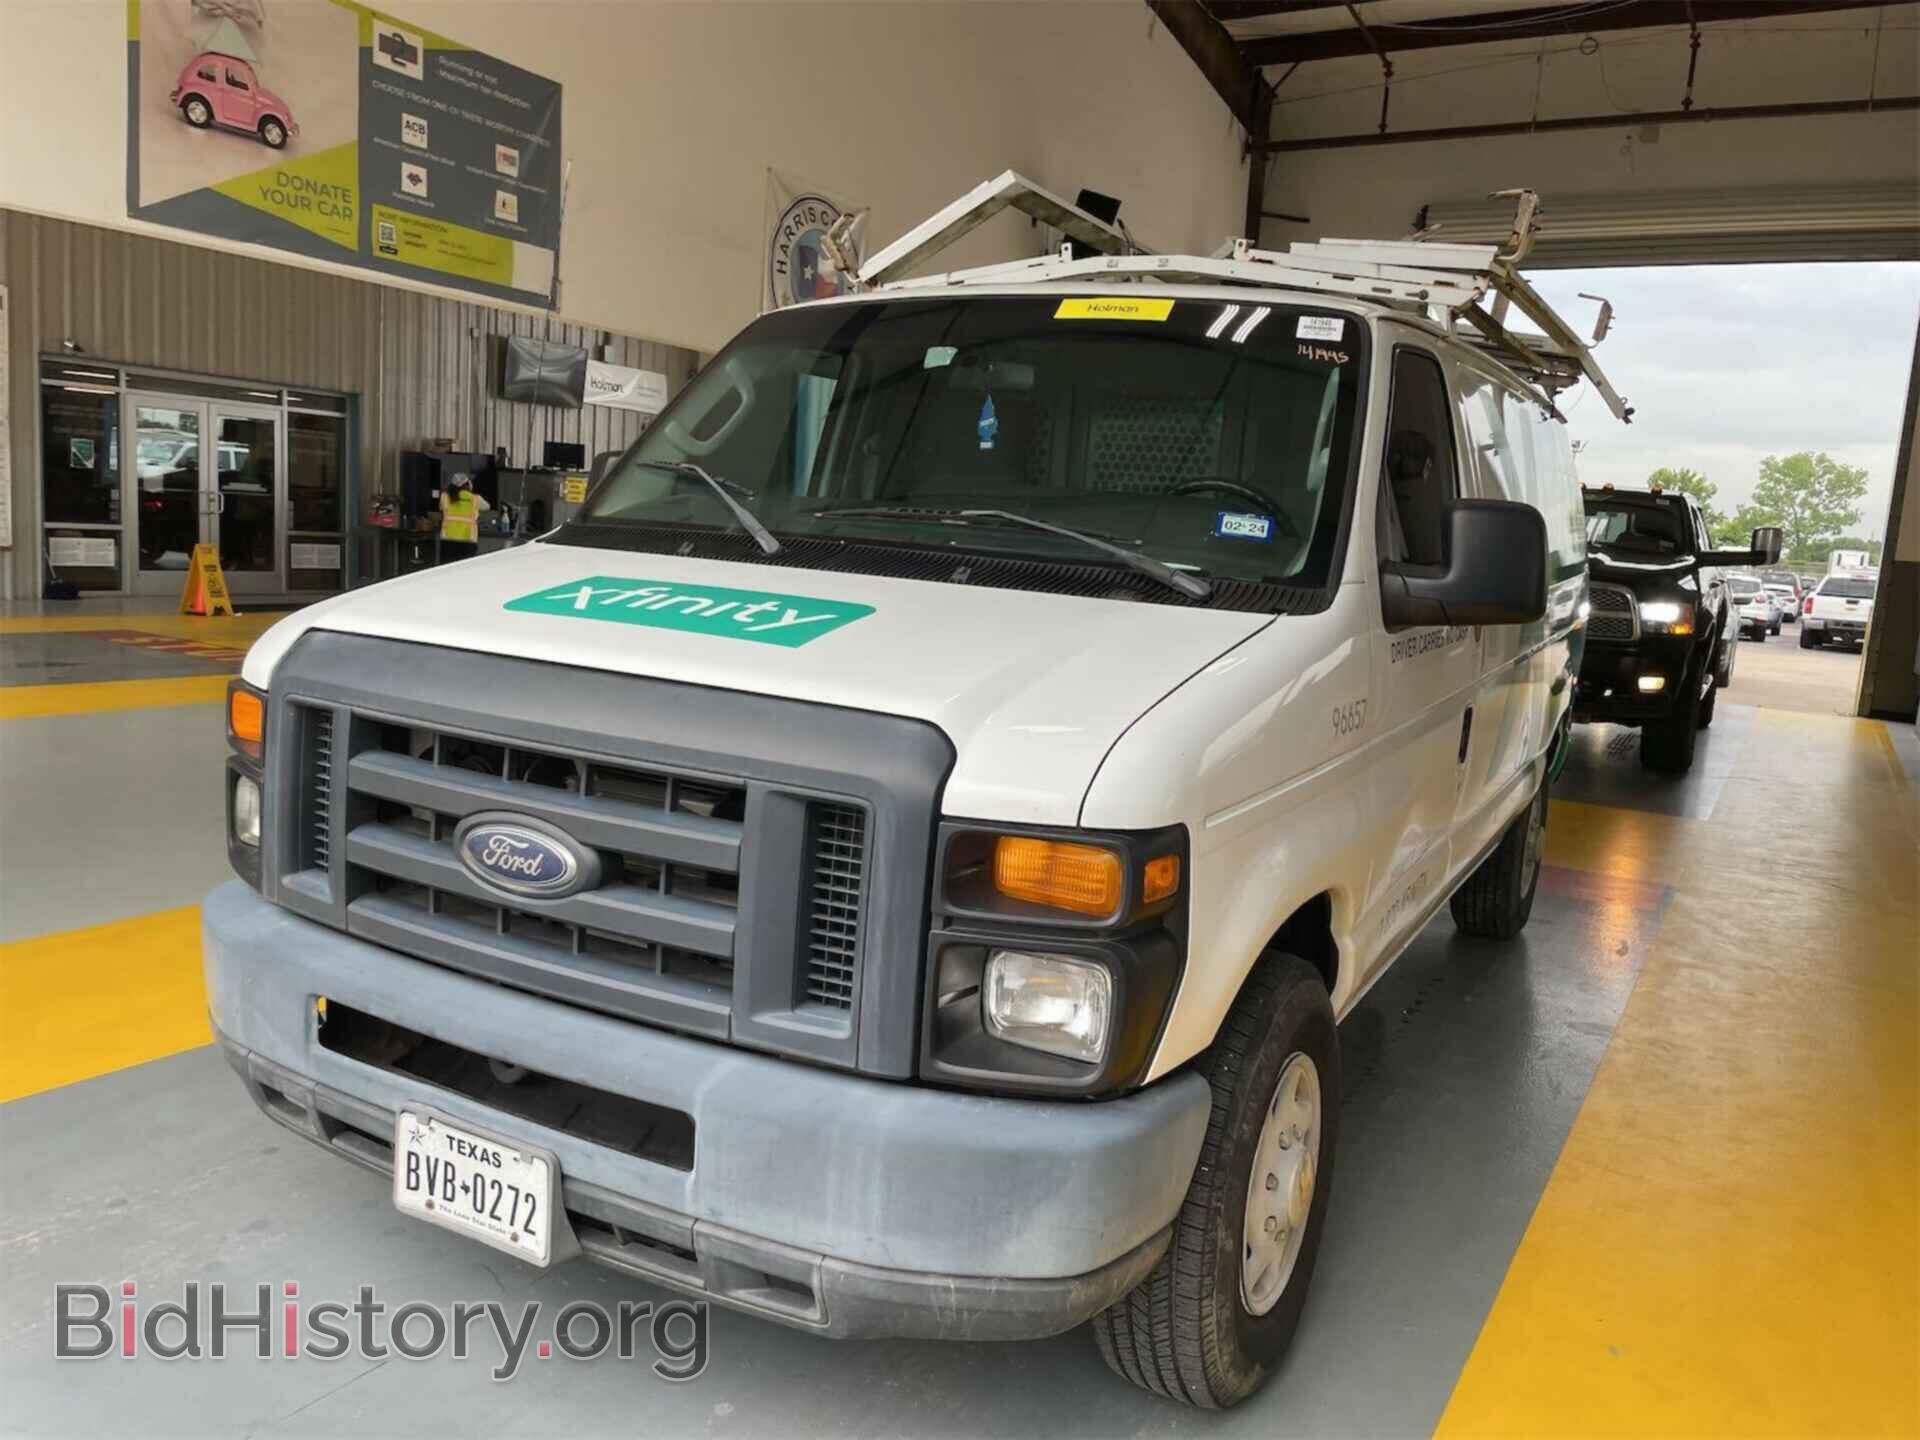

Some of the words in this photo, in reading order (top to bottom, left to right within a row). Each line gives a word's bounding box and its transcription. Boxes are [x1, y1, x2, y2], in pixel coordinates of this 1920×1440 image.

[404, 119, 426, 136] ACB
[258, 184, 312, 211] YOUR
[318, 200, 353, 222] CAR
[276, 171, 353, 204] DONATE
[776, 206, 817, 275] HARRIS
[1087, 303, 1140, 313] Holman
[545, 586, 839, 632] xfinity
[482, 835, 544, 877] Ford
[445, 1134, 502, 1169] TEXAS
